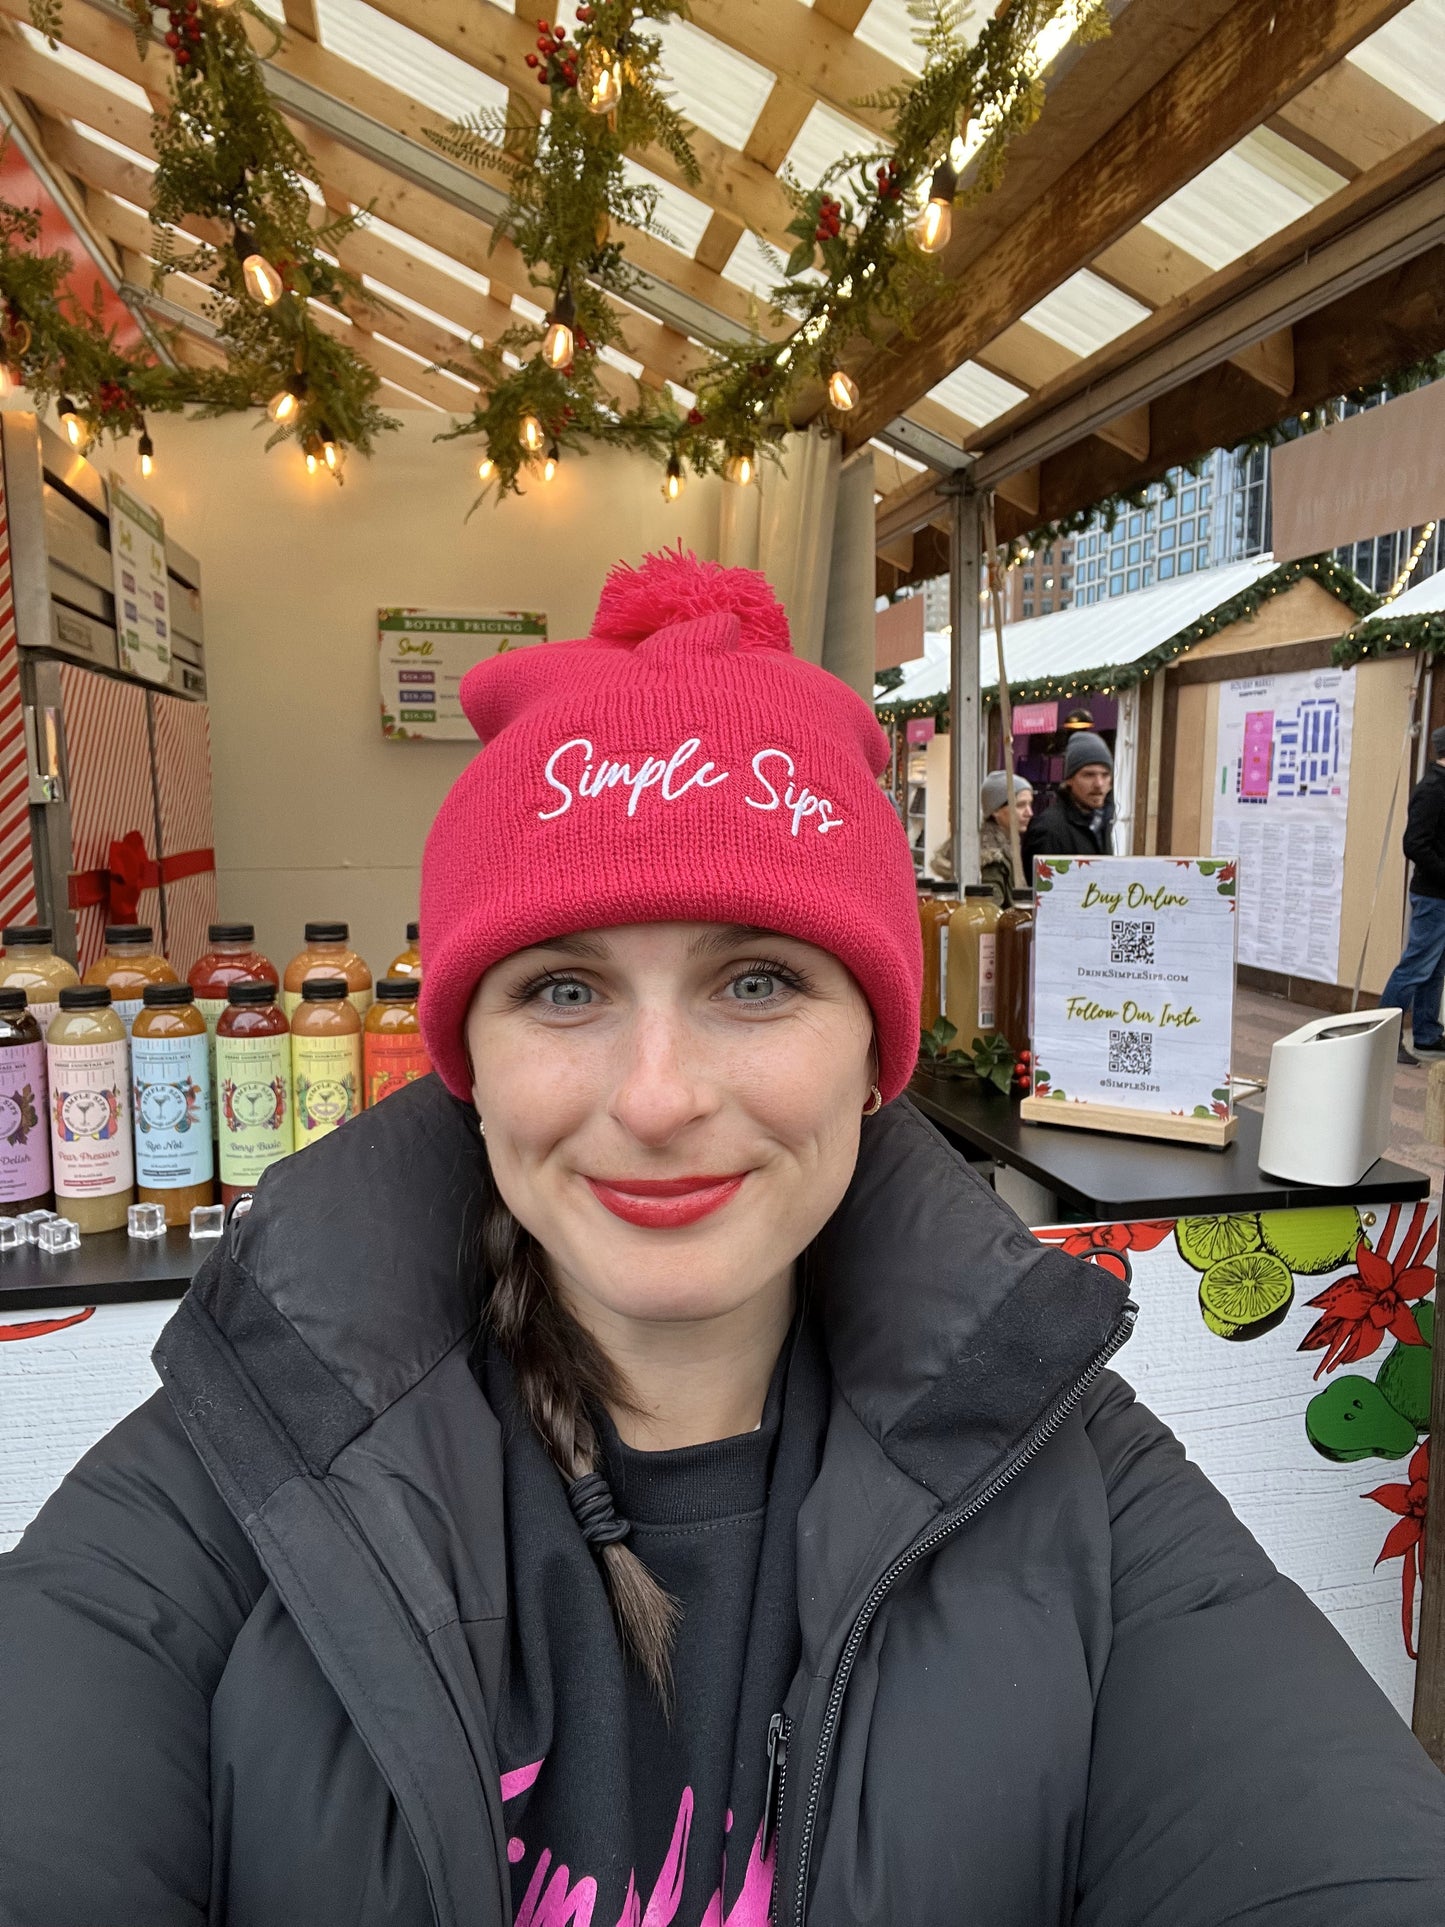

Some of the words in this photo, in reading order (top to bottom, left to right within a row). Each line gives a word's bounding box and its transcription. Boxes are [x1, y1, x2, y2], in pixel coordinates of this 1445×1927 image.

[404, 619, 458, 631] BOTTLE
[464, 621, 523, 633] PRICING
[398, 636, 434, 656] Small
[538, 737, 729, 820] Simple
[745, 748, 843, 837] Sips
[1081, 882, 1122, 914] Buy
[1127, 882, 1189, 911] Online
[1067, 996, 1119, 1021] Follow
[1122, 1000, 1154, 1024] Our
[1158, 1003, 1201, 1028] Insta
[142, 1086, 166, 1106] SIMPLE
[168, 1088, 184, 1105] SIPS
[233, 1085, 258, 1105] SIMPLE
[260, 1086, 275, 1103] SIPS
[308, 1082, 331, 1103] SIMPLE
[64, 1093, 91, 1114] SIMPLE
[92, 1095, 108, 1112] SIPS
[145, 1140, 162, 1152] Rye
[163, 1138, 184, 1150] Not
[230, 1141, 254, 1153] Berry
[257, 1138, 282, 1151] Basic
[58, 1151, 78, 1161] Pear
[79, 1150, 121, 1161] Pressure
